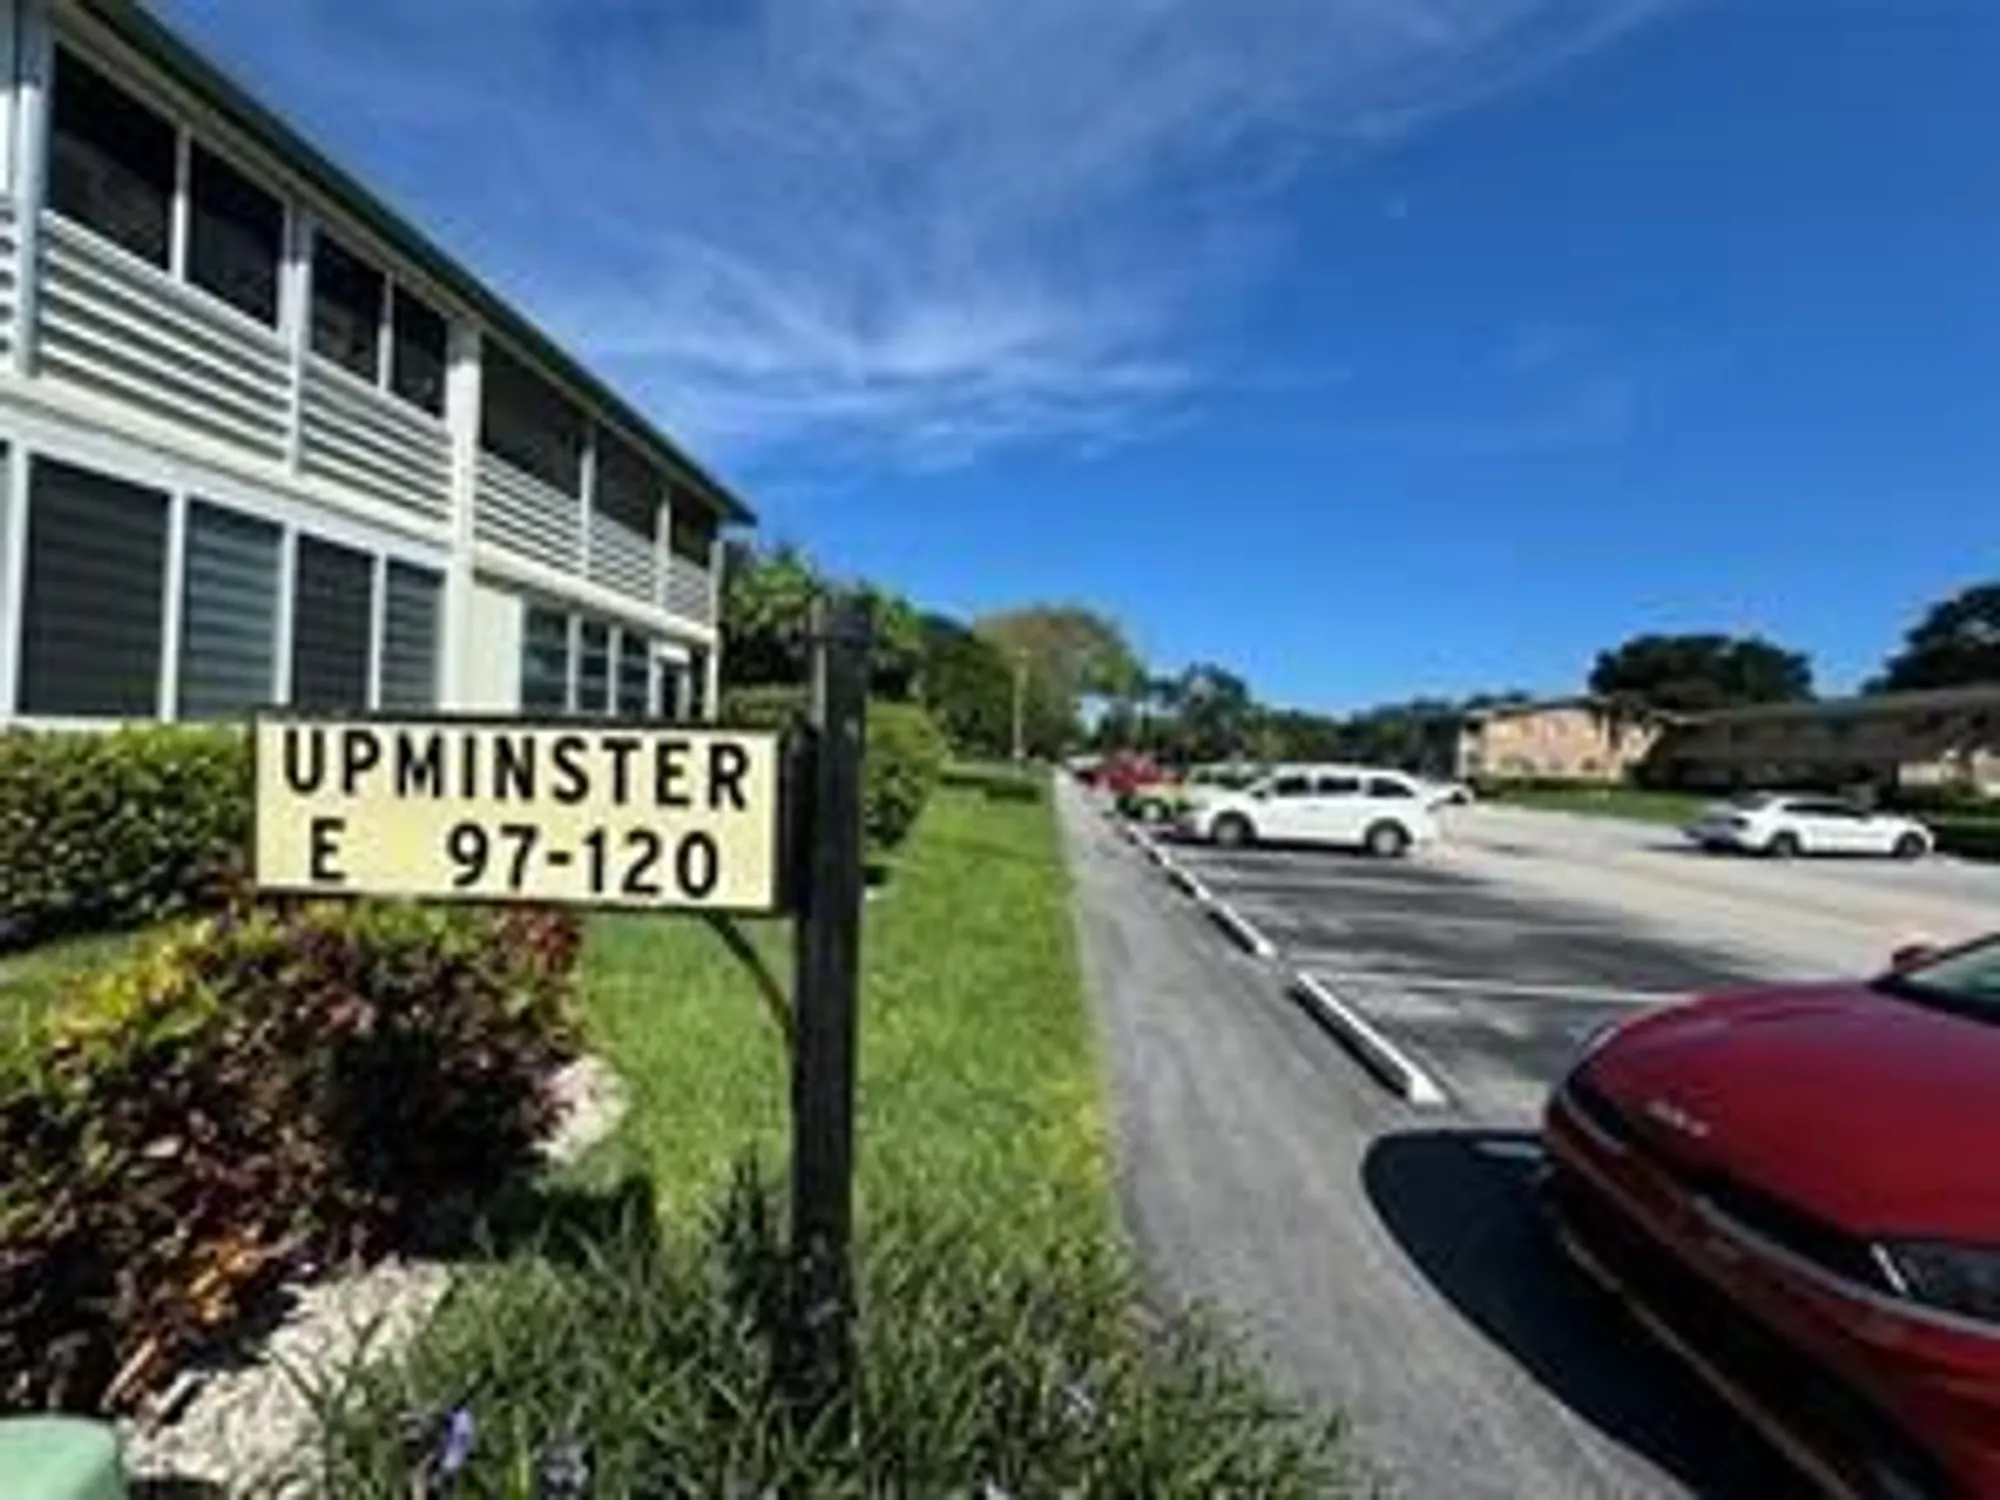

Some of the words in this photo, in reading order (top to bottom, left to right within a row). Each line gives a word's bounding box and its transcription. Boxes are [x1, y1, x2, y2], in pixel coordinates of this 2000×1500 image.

[284, 728, 749, 811] UPMINSTER
[310, 817, 345, 883] E
[447, 822, 718, 899] 97-120
